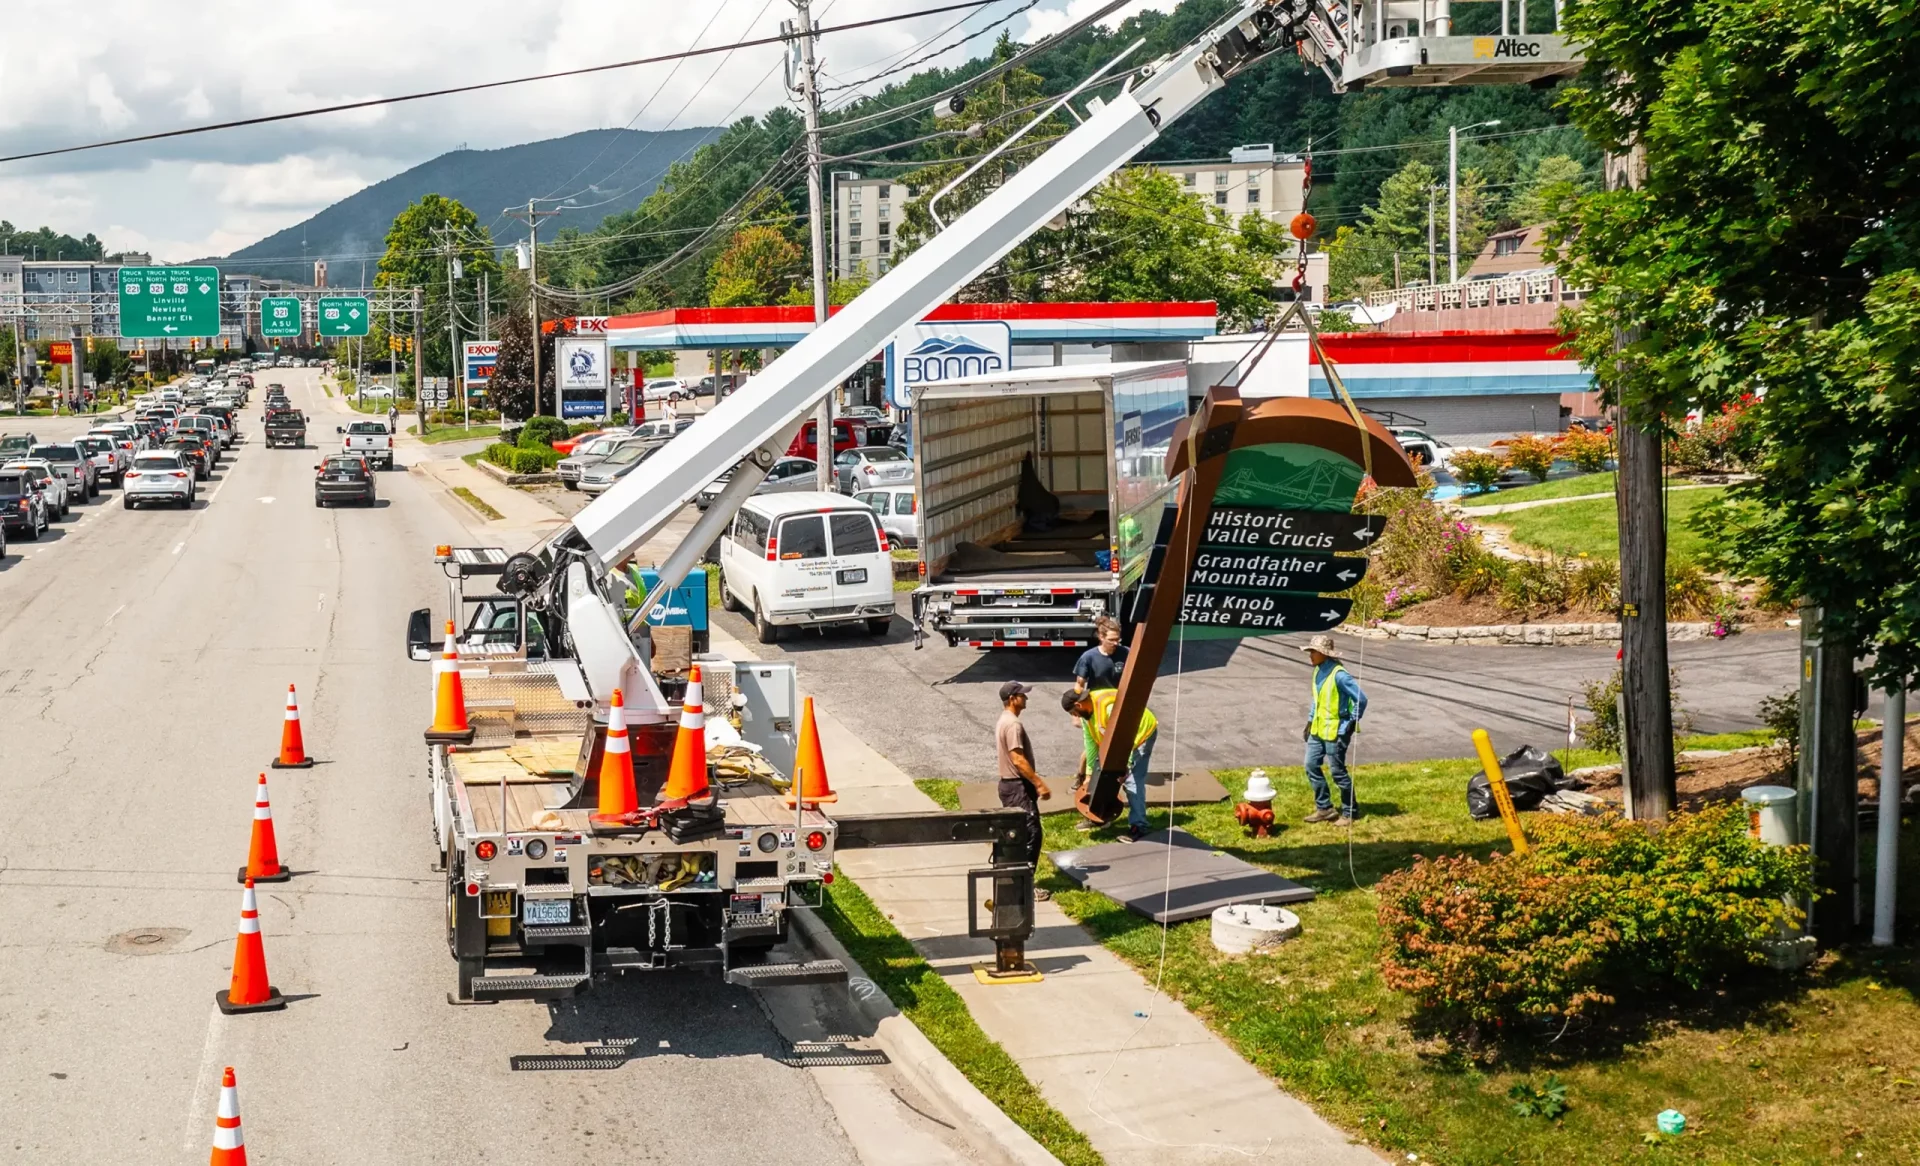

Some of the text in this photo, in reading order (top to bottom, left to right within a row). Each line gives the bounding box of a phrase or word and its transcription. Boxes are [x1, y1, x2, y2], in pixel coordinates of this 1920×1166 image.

[1494, 38, 1541, 57] Altec
[150, 285, 163, 293] 321
[174, 285, 188, 293] 421
[275, 309, 287, 317] 321
[581, 318, 608, 332] EXXO
[468, 345, 498, 356] EXXON
[1124, 426, 1141, 447] PENSKE
[1211, 511, 1294, 529] Historic
[1207, 528, 1335, 548] Valle Crucis
[1197, 554, 1326, 573] Grandfather
[1192, 570, 1289, 587] Mountain
[666, 606, 688, 615] Miller
[1184, 594, 1275, 611] Elk Knob
[1178, 609, 1286, 627] State Park
